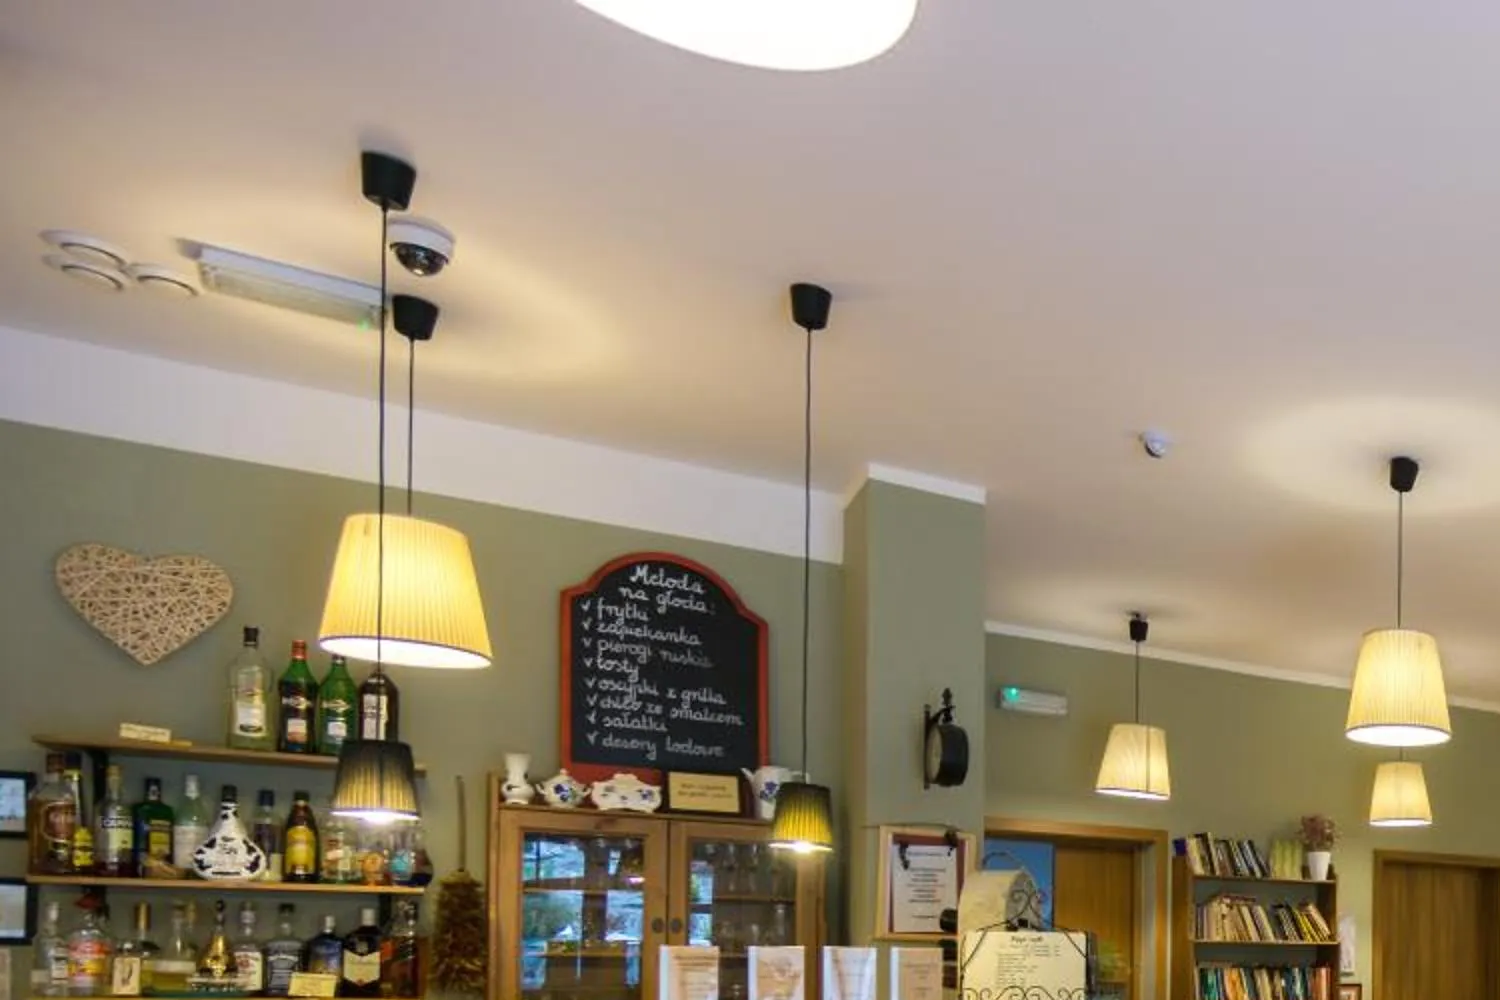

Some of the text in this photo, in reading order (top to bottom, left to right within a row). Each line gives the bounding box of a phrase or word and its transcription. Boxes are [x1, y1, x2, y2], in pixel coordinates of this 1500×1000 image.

[619, 587, 649, 600] na
[597, 598, 649, 625] frytki
[597, 623, 703, 646] zapiekanka
[597, 639, 651, 663] pierogi
[597, 658, 639, 682] tosty
[598, 678, 727, 709] oscypki z grilla
[646, 702, 663, 715] ze
[670, 704, 744, 726] smalcem
[602, 732, 725, 761] desery lodowe
